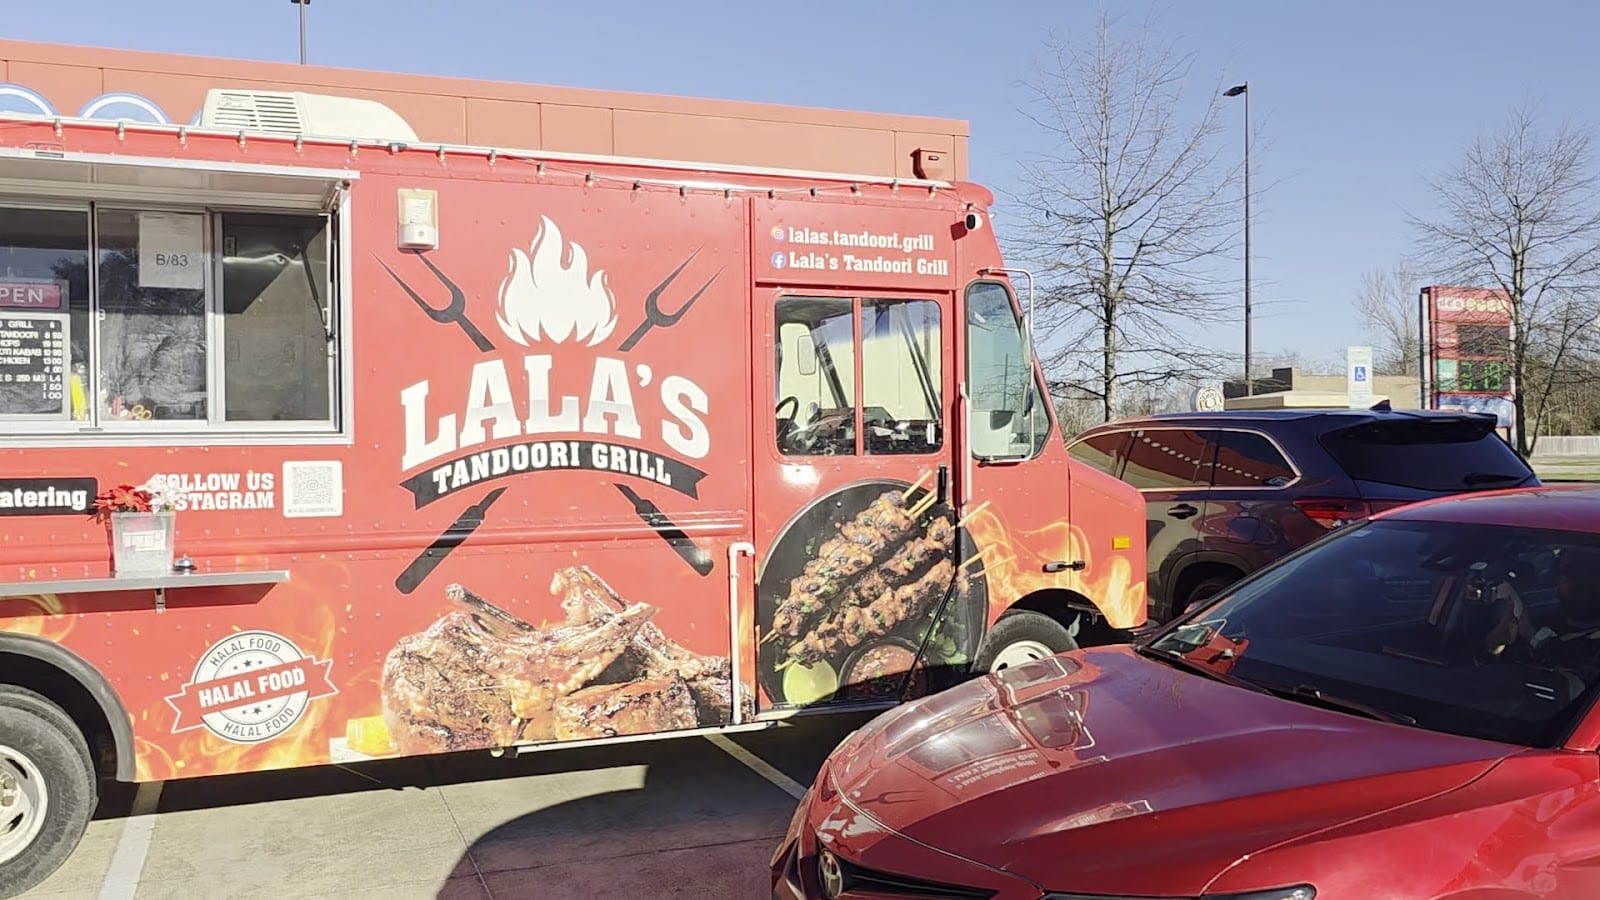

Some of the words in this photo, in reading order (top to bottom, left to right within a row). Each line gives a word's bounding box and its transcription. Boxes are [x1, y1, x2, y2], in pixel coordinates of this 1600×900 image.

[788, 227, 934, 253] lalas.tandoori.grill
[155, 253, 189, 267] B/83
[788, 251, 839, 271] Lala's
[843, 254, 912, 274] Tandoori
[916, 258, 948, 276] Grill
[0, 287, 44, 304] PEN
[400, 354, 710, 472] LALA'S
[432, 440, 580, 494] TANDOORI
[591, 444, 672, 486] GRILL
[246, 472, 275, 490] US
[0, 486, 87, 511] atering
[174, 491, 275, 511] STAGRAM
[209, 640, 245, 667] HALAL
[249, 638, 281, 653] FOOD
[198, 679, 255, 708] HALAL
[257, 668, 305, 694] FOOD
[223, 722, 262, 737] HALAL
[266, 707, 294, 733] FOOD
